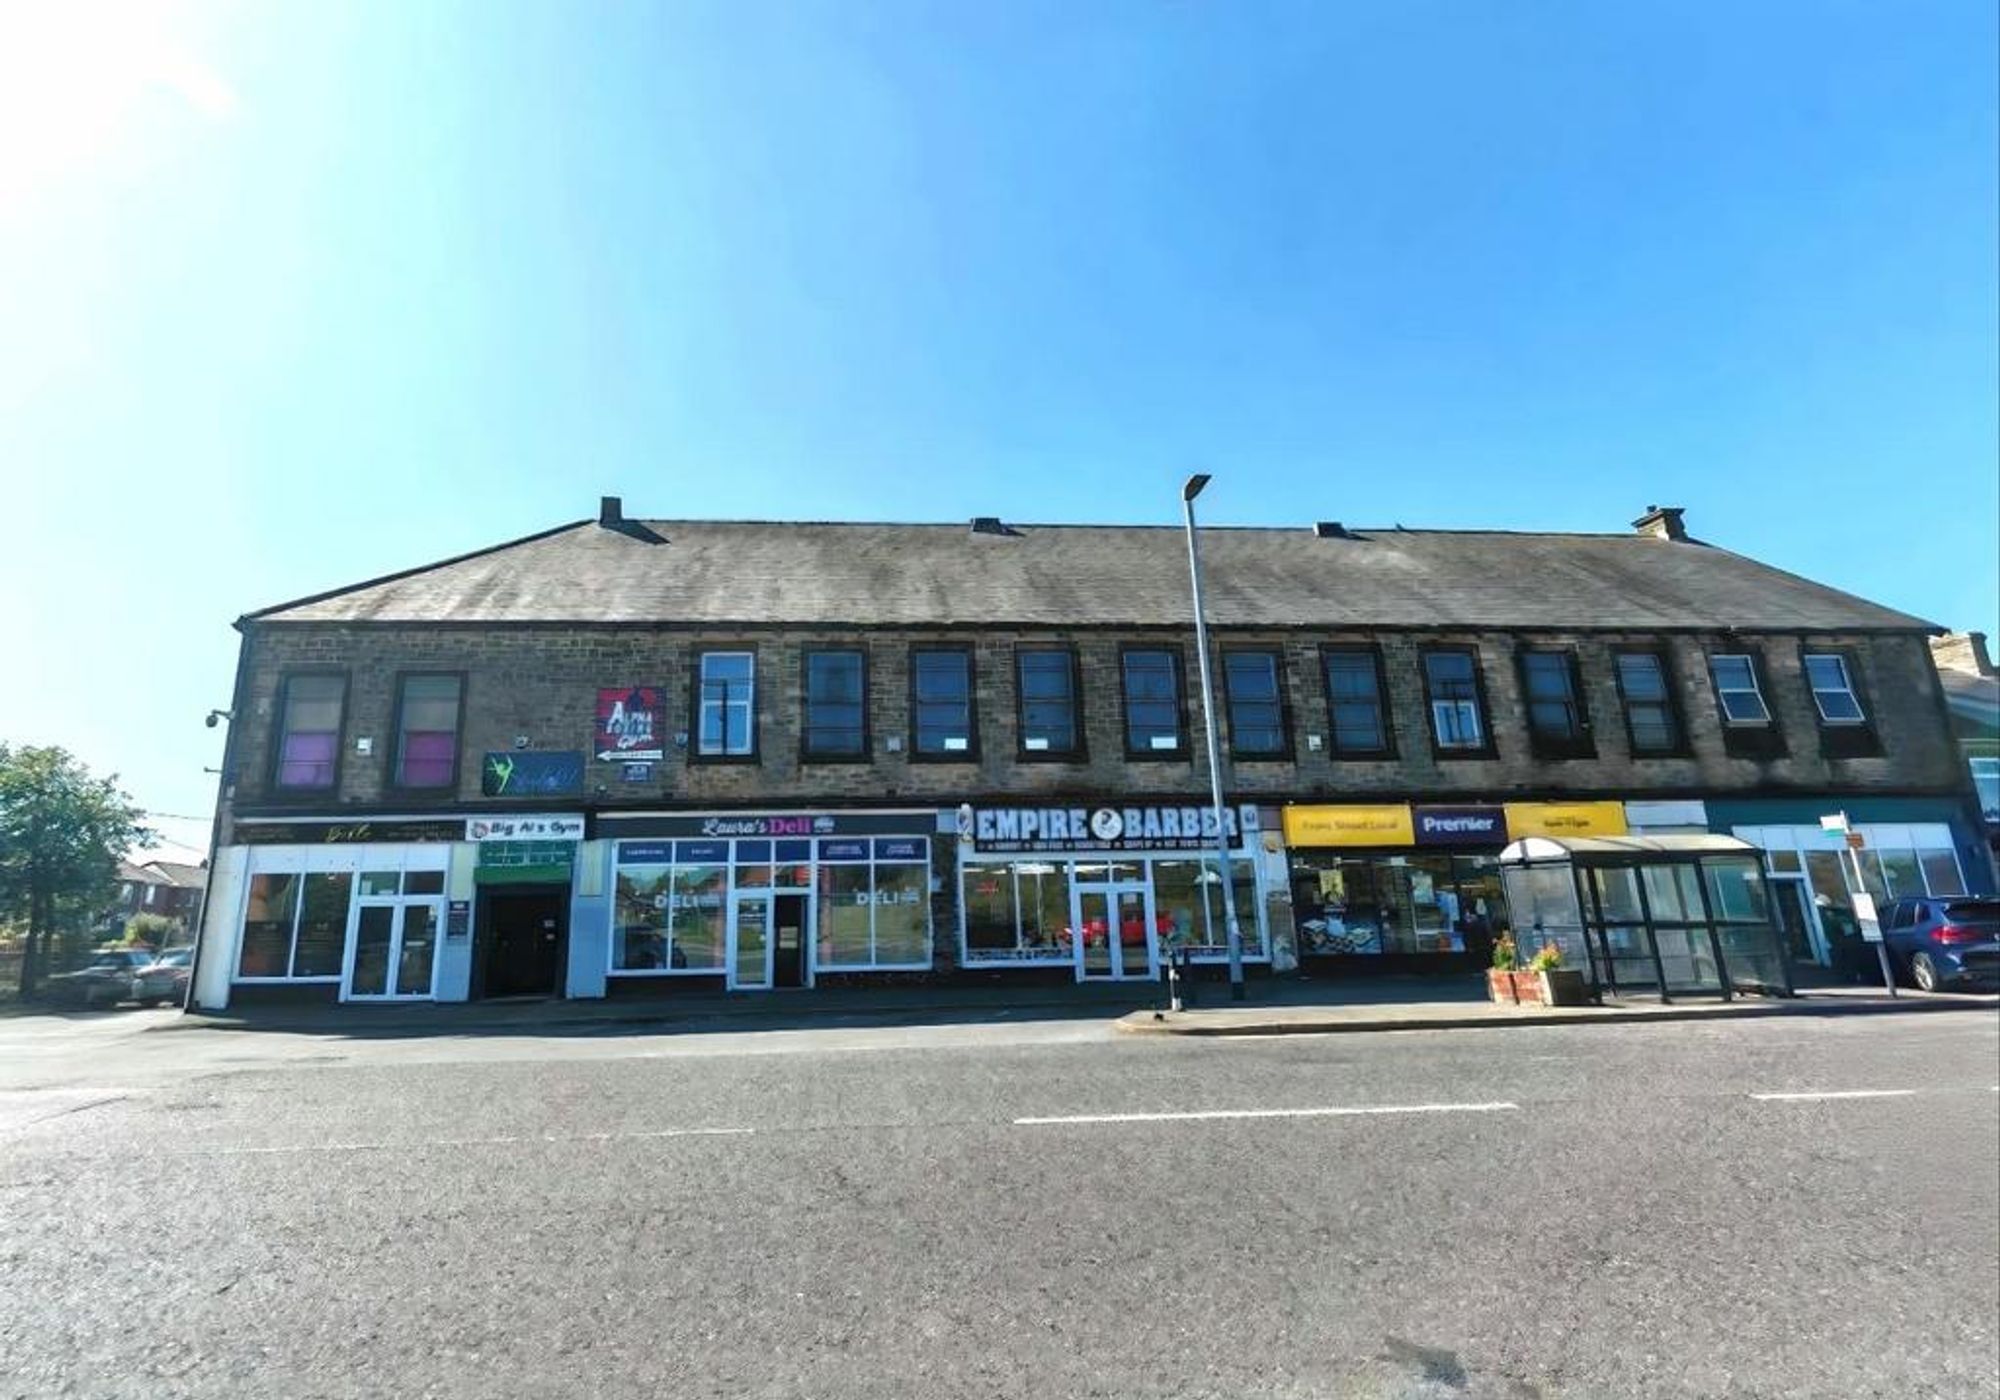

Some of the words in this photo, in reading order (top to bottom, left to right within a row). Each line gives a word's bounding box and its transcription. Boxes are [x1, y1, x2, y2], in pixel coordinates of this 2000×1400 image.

[491, 821, 514, 836] Big
[551, 821, 580, 835] Gym
[702, 817, 768, 836] Laura's
[769, 817, 812, 834] Deli
[976, 808, 1088, 839] EMPIRE
[1123, 806, 1237, 837] BARBER
[1423, 816, 1493, 832] Premier
